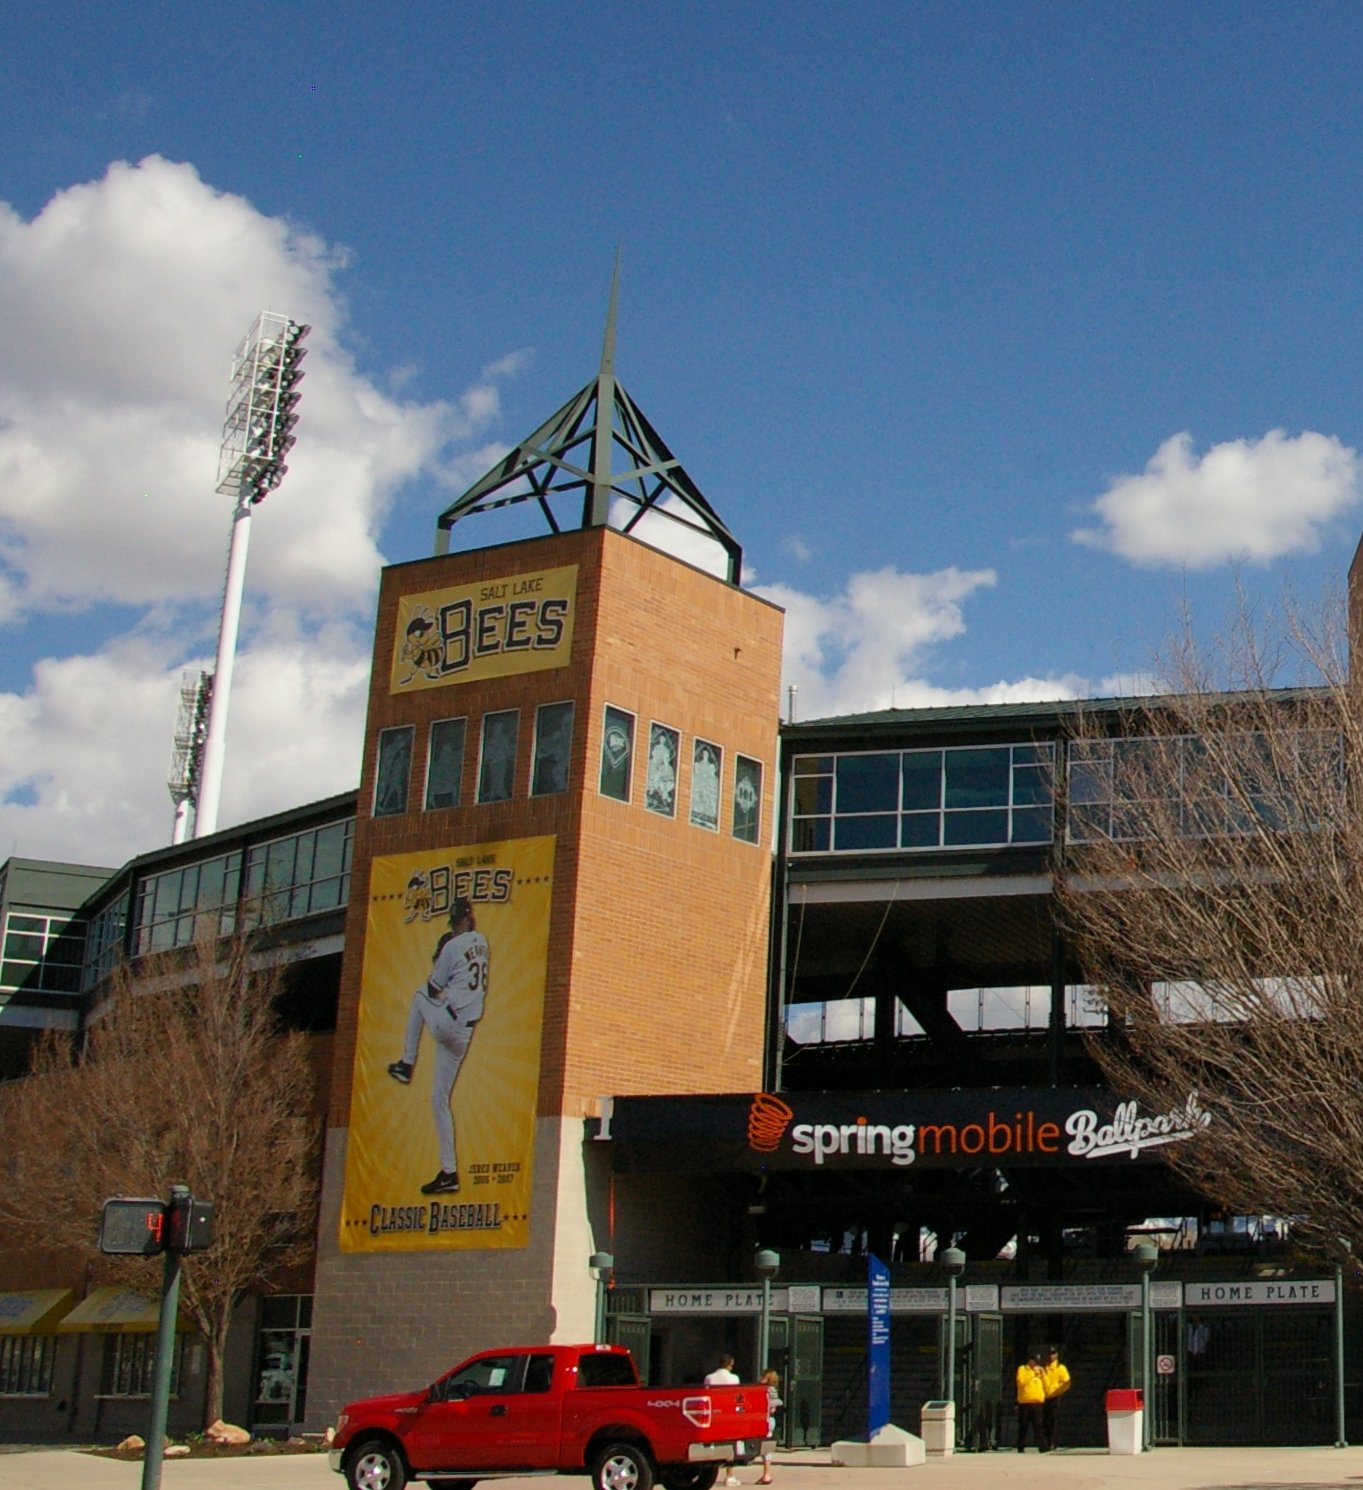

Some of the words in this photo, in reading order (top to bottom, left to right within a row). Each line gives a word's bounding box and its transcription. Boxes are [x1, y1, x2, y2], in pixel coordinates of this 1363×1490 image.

[480, 584, 509, 601] SALT
[513, 578, 544, 595] LAKE
[437, 598, 569, 675] BEES
[429, 865, 513, 915] BEES
[1065, 1089, 1212, 1160] Ballpark
[370, 1203, 427, 1236] CLASSIC
[429, 1201, 502, 1235] BASEBALL
[665, 1294, 714, 1307] HOME
[1201, 1287, 1253, 1300] HOME
[1267, 1285, 1320, 1299] PLATE
